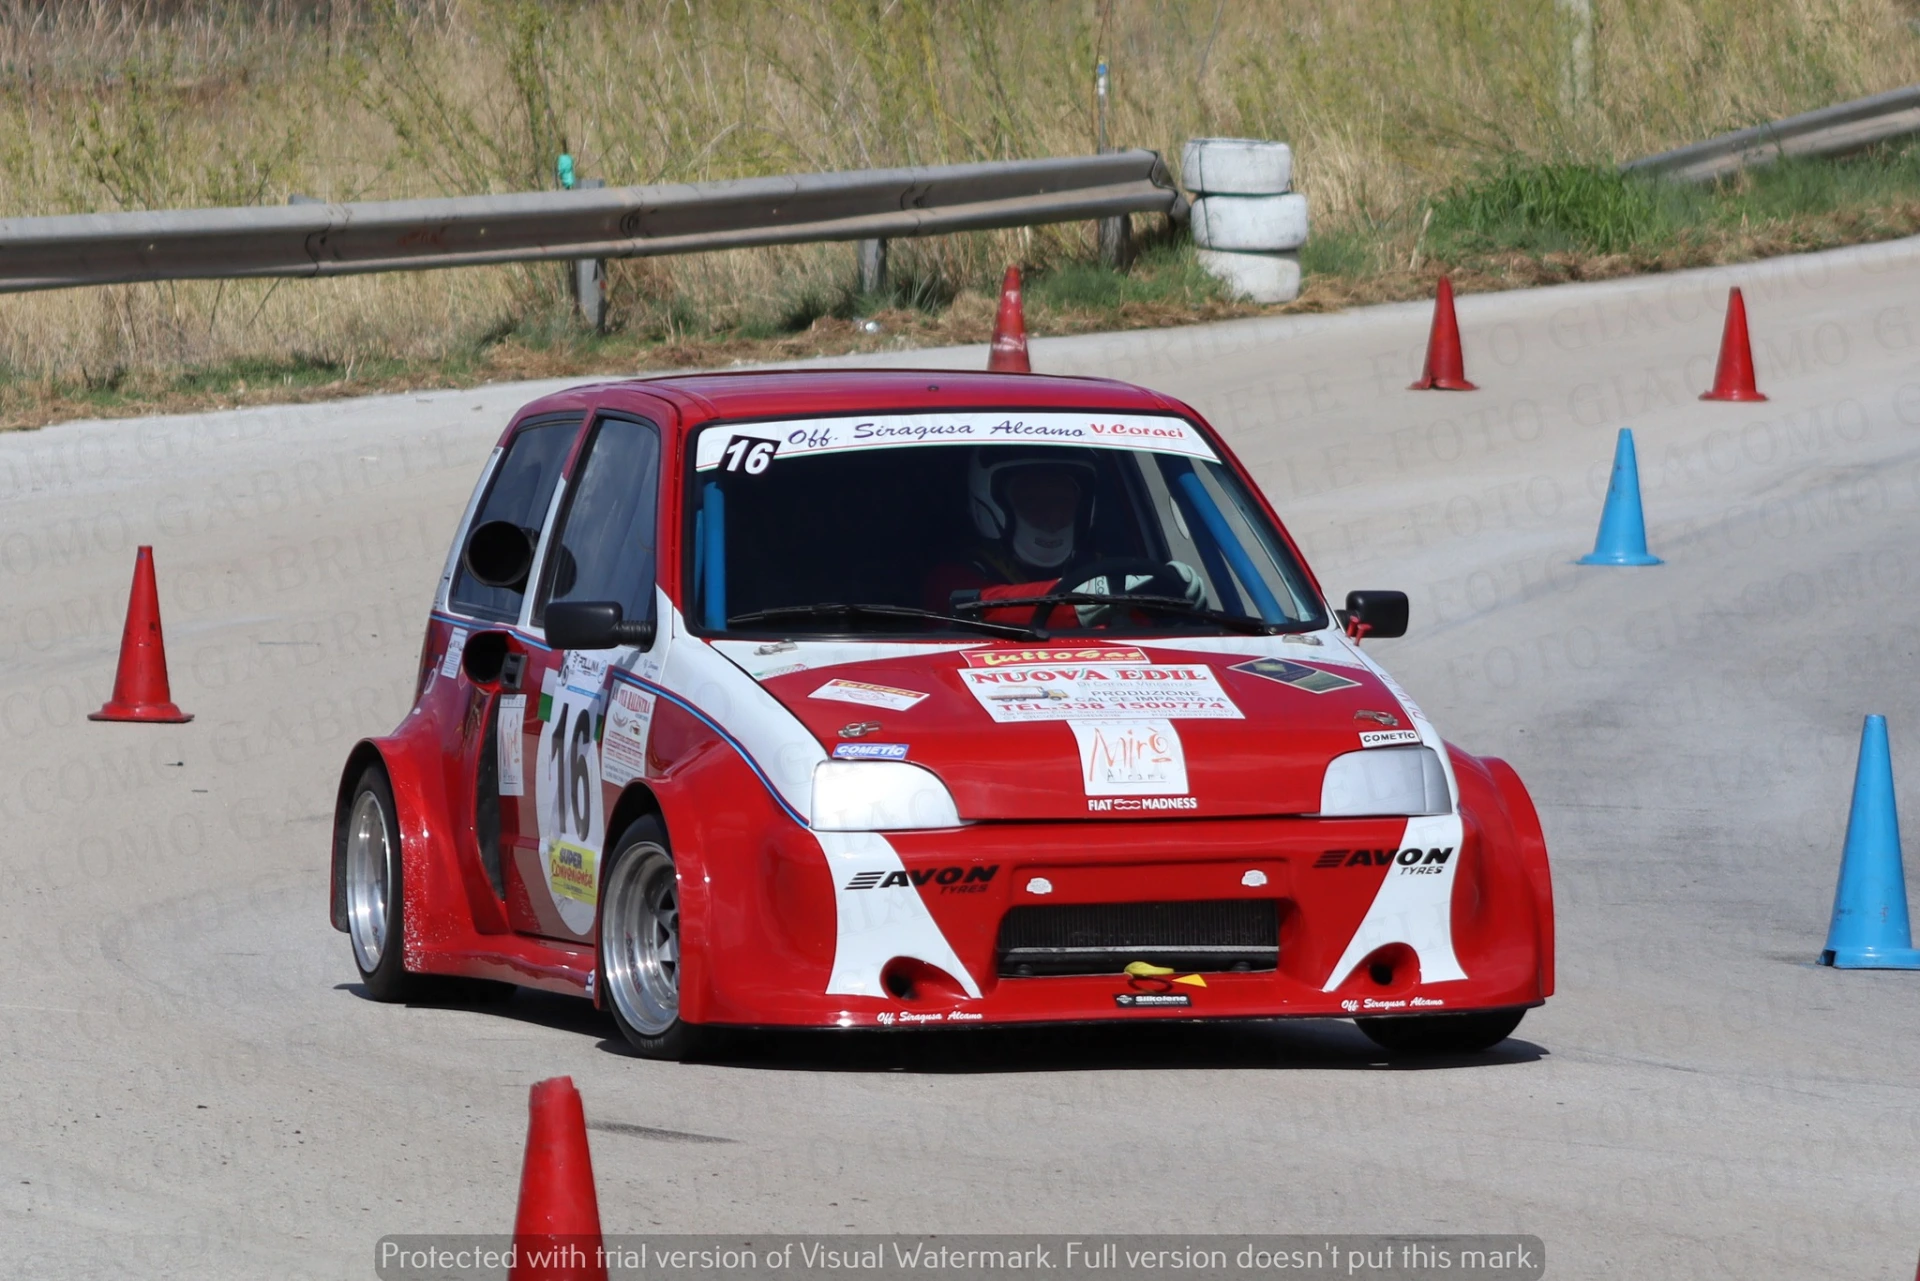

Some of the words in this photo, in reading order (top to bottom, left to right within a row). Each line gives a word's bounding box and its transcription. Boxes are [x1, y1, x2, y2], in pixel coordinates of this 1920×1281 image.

[787, 429, 838, 448] Off.
[854, 421, 973, 440] Siragusa
[990, 419, 1086, 437] Alcamo
[725, 439, 773, 475] 16
[970, 667, 1109, 684] NUOVA
[1116, 667, 1207, 681] EDIL
[1091, 689, 1201, 697] PRODUZIONE
[1114, 701, 1225, 709] 1500774
[552, 702, 592, 842] 16
[1088, 799, 1113, 811] FIAT
[1142, 797, 1198, 809] MADNESS
[1344, 847, 1453, 867] AVON
[880, 866, 1000, 888] AVON
[1400, 865, 1444, 876] TYRES
[939, 883, 988, 895] TYRES
[1363, 998, 1405, 1010] Siragusa
[1408, 996, 1444, 1009] Alcamo
[899, 1010, 942, 1023] Siragusa
[947, 1010, 983, 1022] Alcamo
